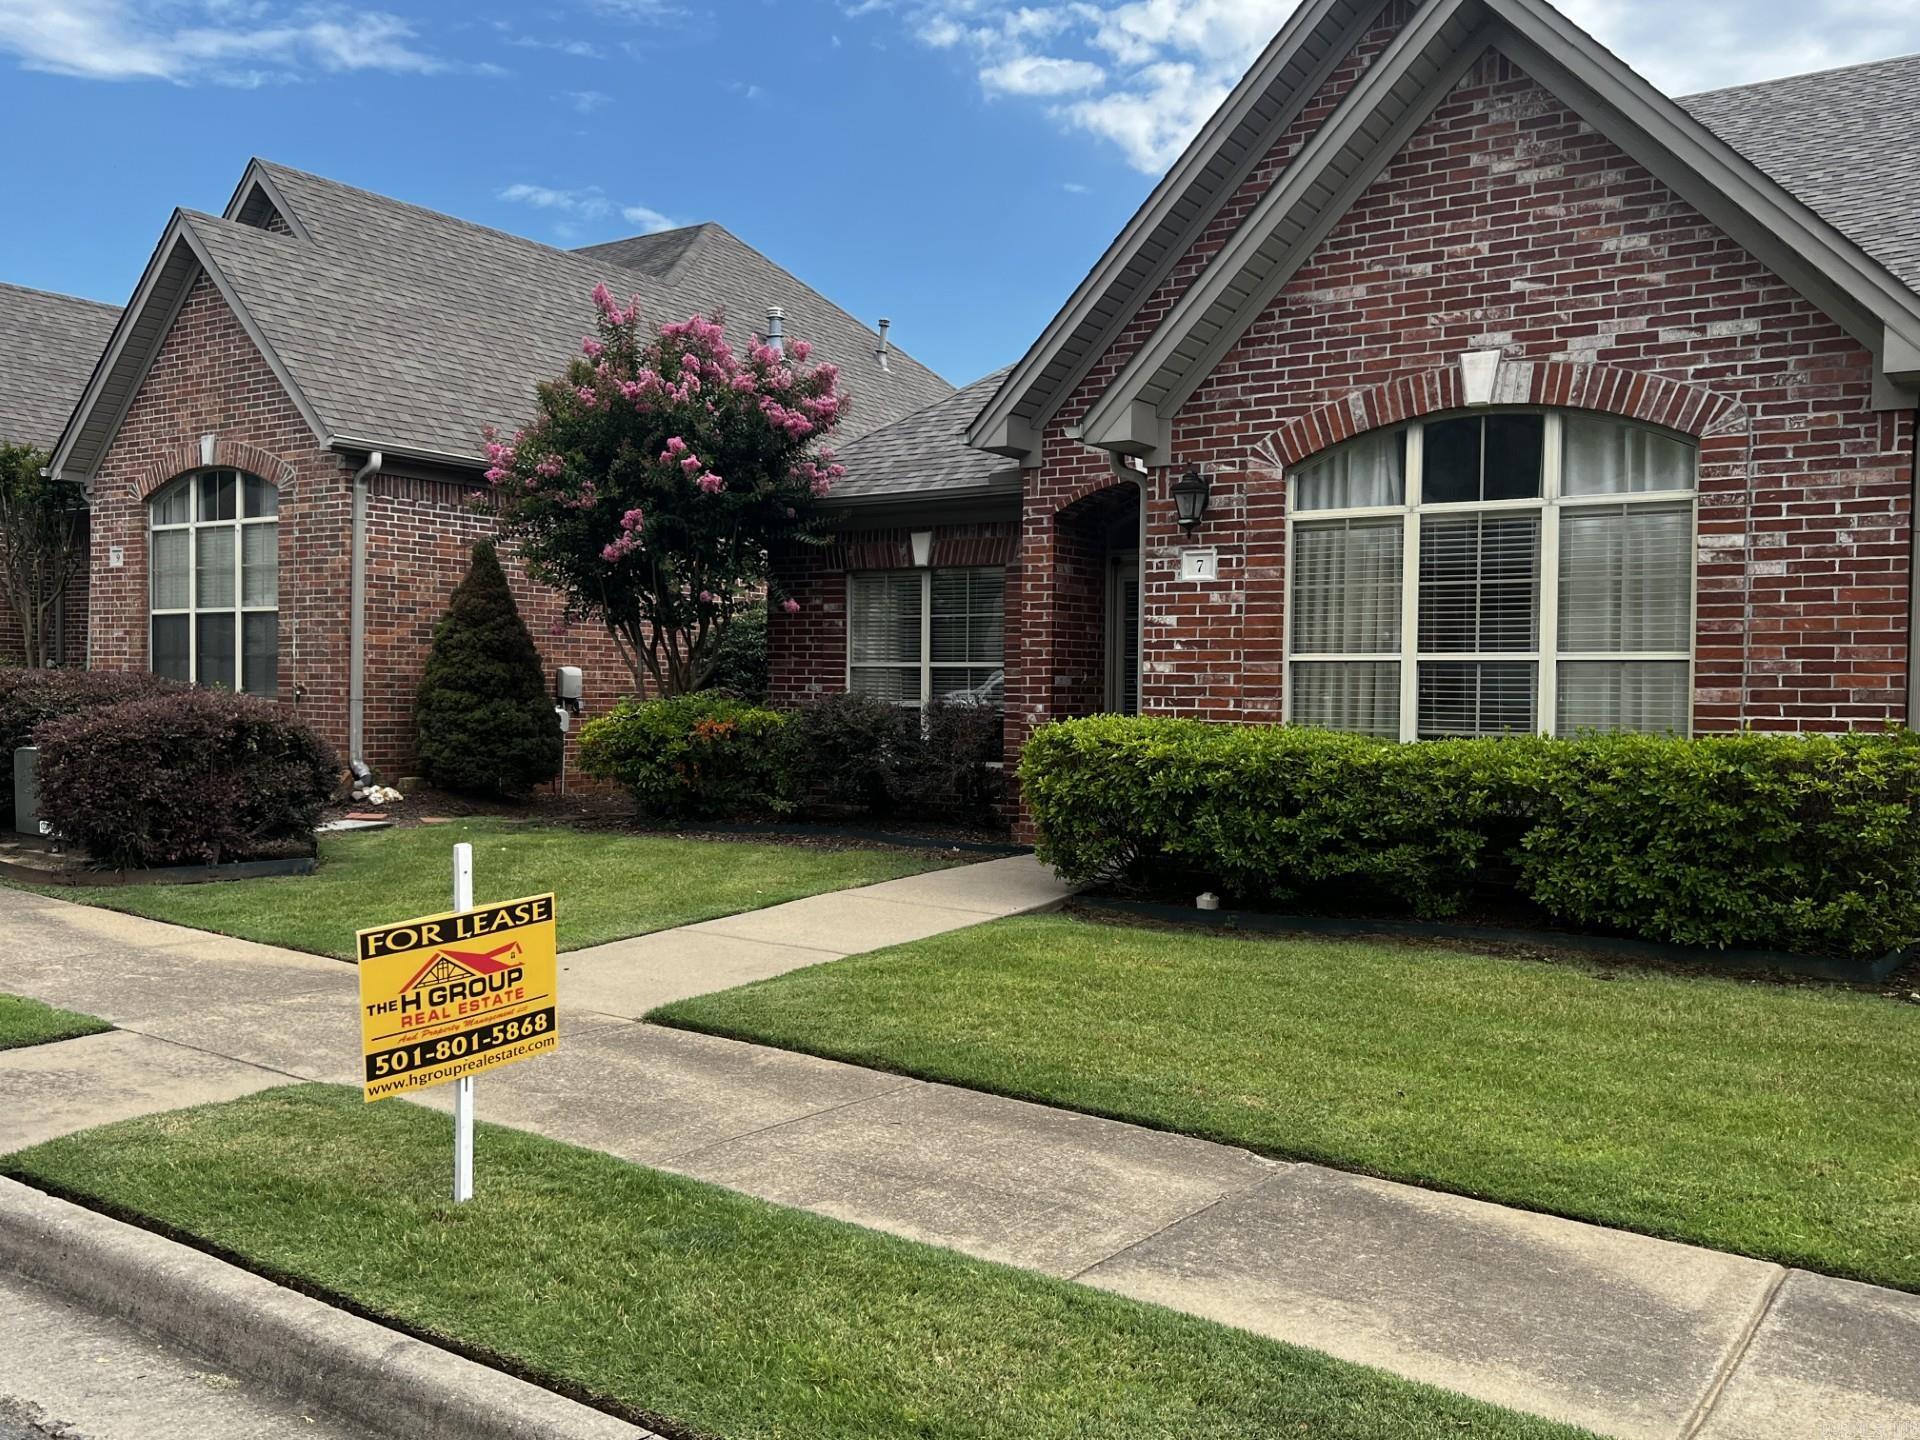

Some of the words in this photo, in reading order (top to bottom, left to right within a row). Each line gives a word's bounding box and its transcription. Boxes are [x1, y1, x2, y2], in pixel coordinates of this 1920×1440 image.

[1196, 559, 1204, 573] 7
[367, 923, 444, 955] FOR
[456, 900, 547, 938] LEASE
[366, 999, 398, 1017] THE
[401, 992, 421, 1014] H
[428, 967, 523, 1008] GROUP
[401, 1006, 451, 1029] REAL
[458, 986, 525, 1014] ESTATE
[375, 1013, 548, 1075] 501-801-5868
[397, 1027, 418, 1044] And
[421, 1021, 461, 1039] Property
[463, 1009, 515, 1029] Management
[368, 1036, 555, 1096] www.hgrouprealestate.com
